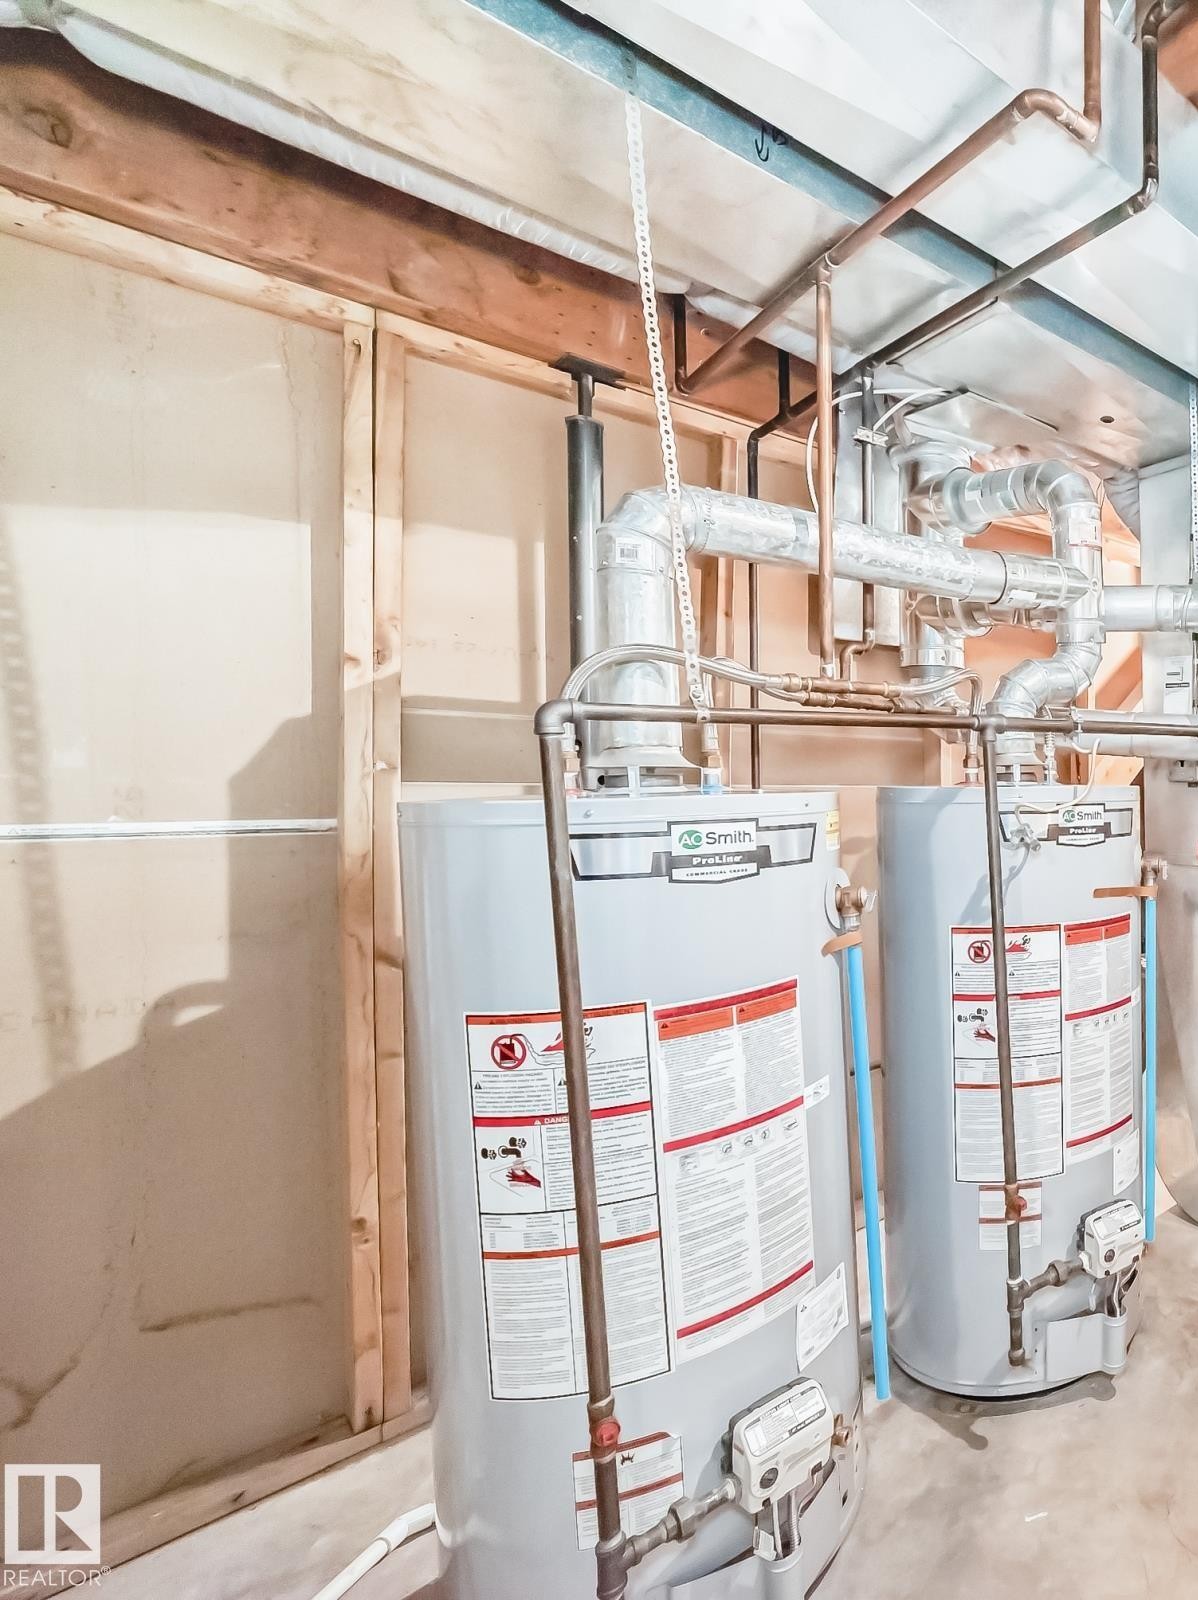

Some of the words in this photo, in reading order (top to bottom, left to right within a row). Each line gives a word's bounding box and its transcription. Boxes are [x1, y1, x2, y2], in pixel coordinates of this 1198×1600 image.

[1077, 810, 1103, 820] Smith
[692, 855, 743, 865] ProLine
[544, 1116, 569, 1124] DANG
